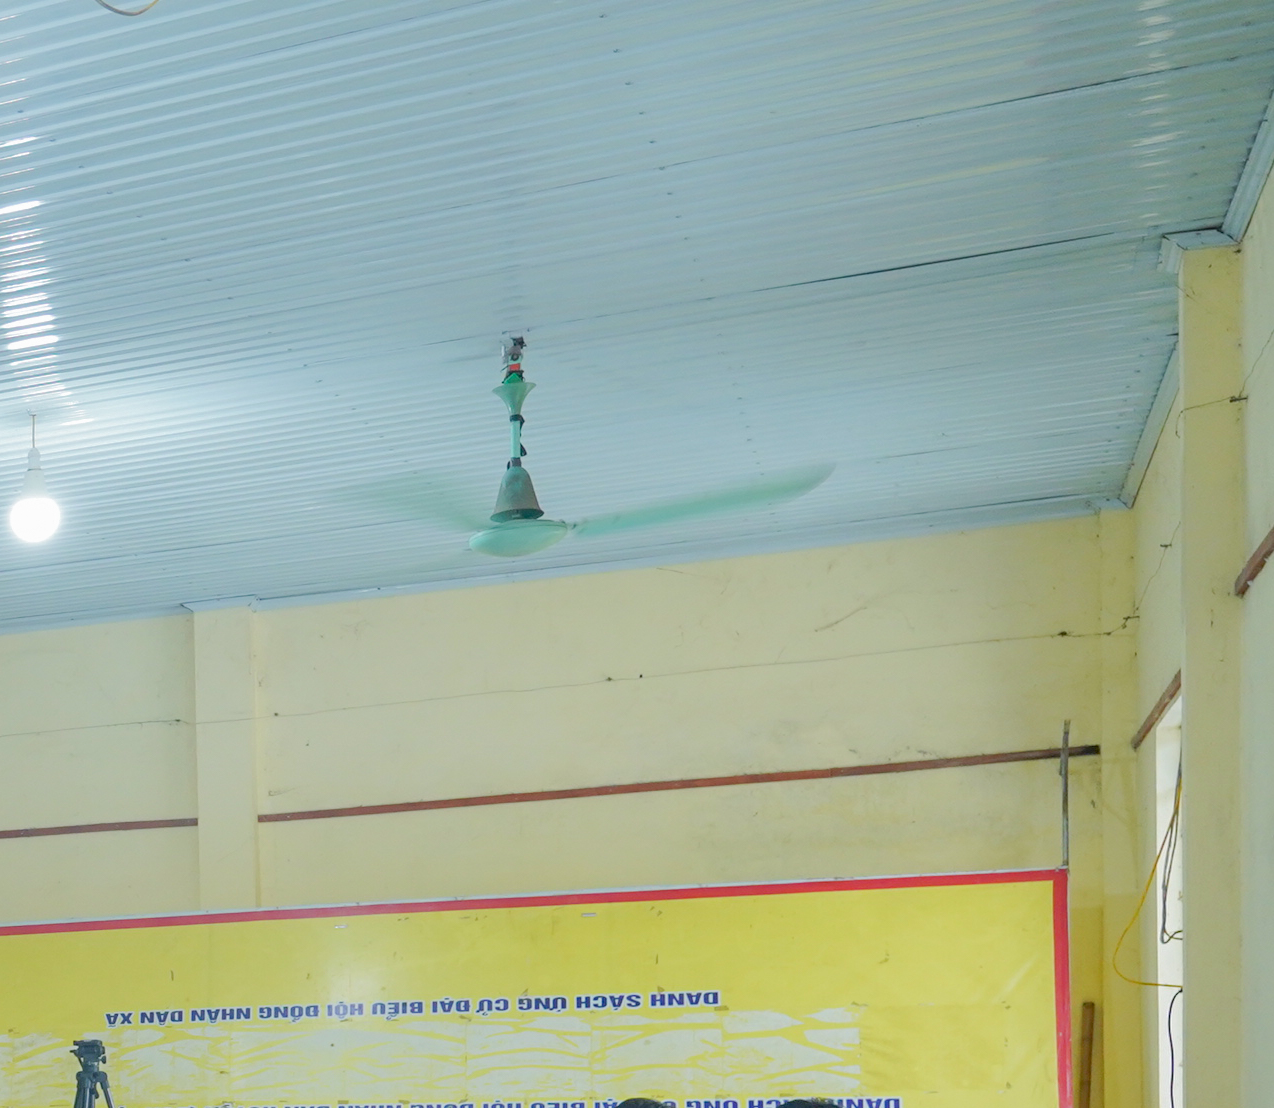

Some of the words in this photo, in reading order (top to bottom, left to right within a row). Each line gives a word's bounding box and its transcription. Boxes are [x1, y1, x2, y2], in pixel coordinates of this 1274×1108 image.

[432, 997, 471, 1014] ĐẠI
[476, 998, 510, 1016] CỬ
[517, 996, 568, 1015] ỨNG
[575, 994, 642, 1012] SÁCH
[650, 992, 720, 1007] DANH
[140, 1010, 183, 1027] DÂN
[190, 1007, 251, 1024] NHÂN
[258, 1004, 320, 1022] ĐỒNG
[327, 1001, 365, 1019] HỘI
[372, 1001, 424, 1021] BIỂU
[105, 1012, 133, 1028] XÃ
